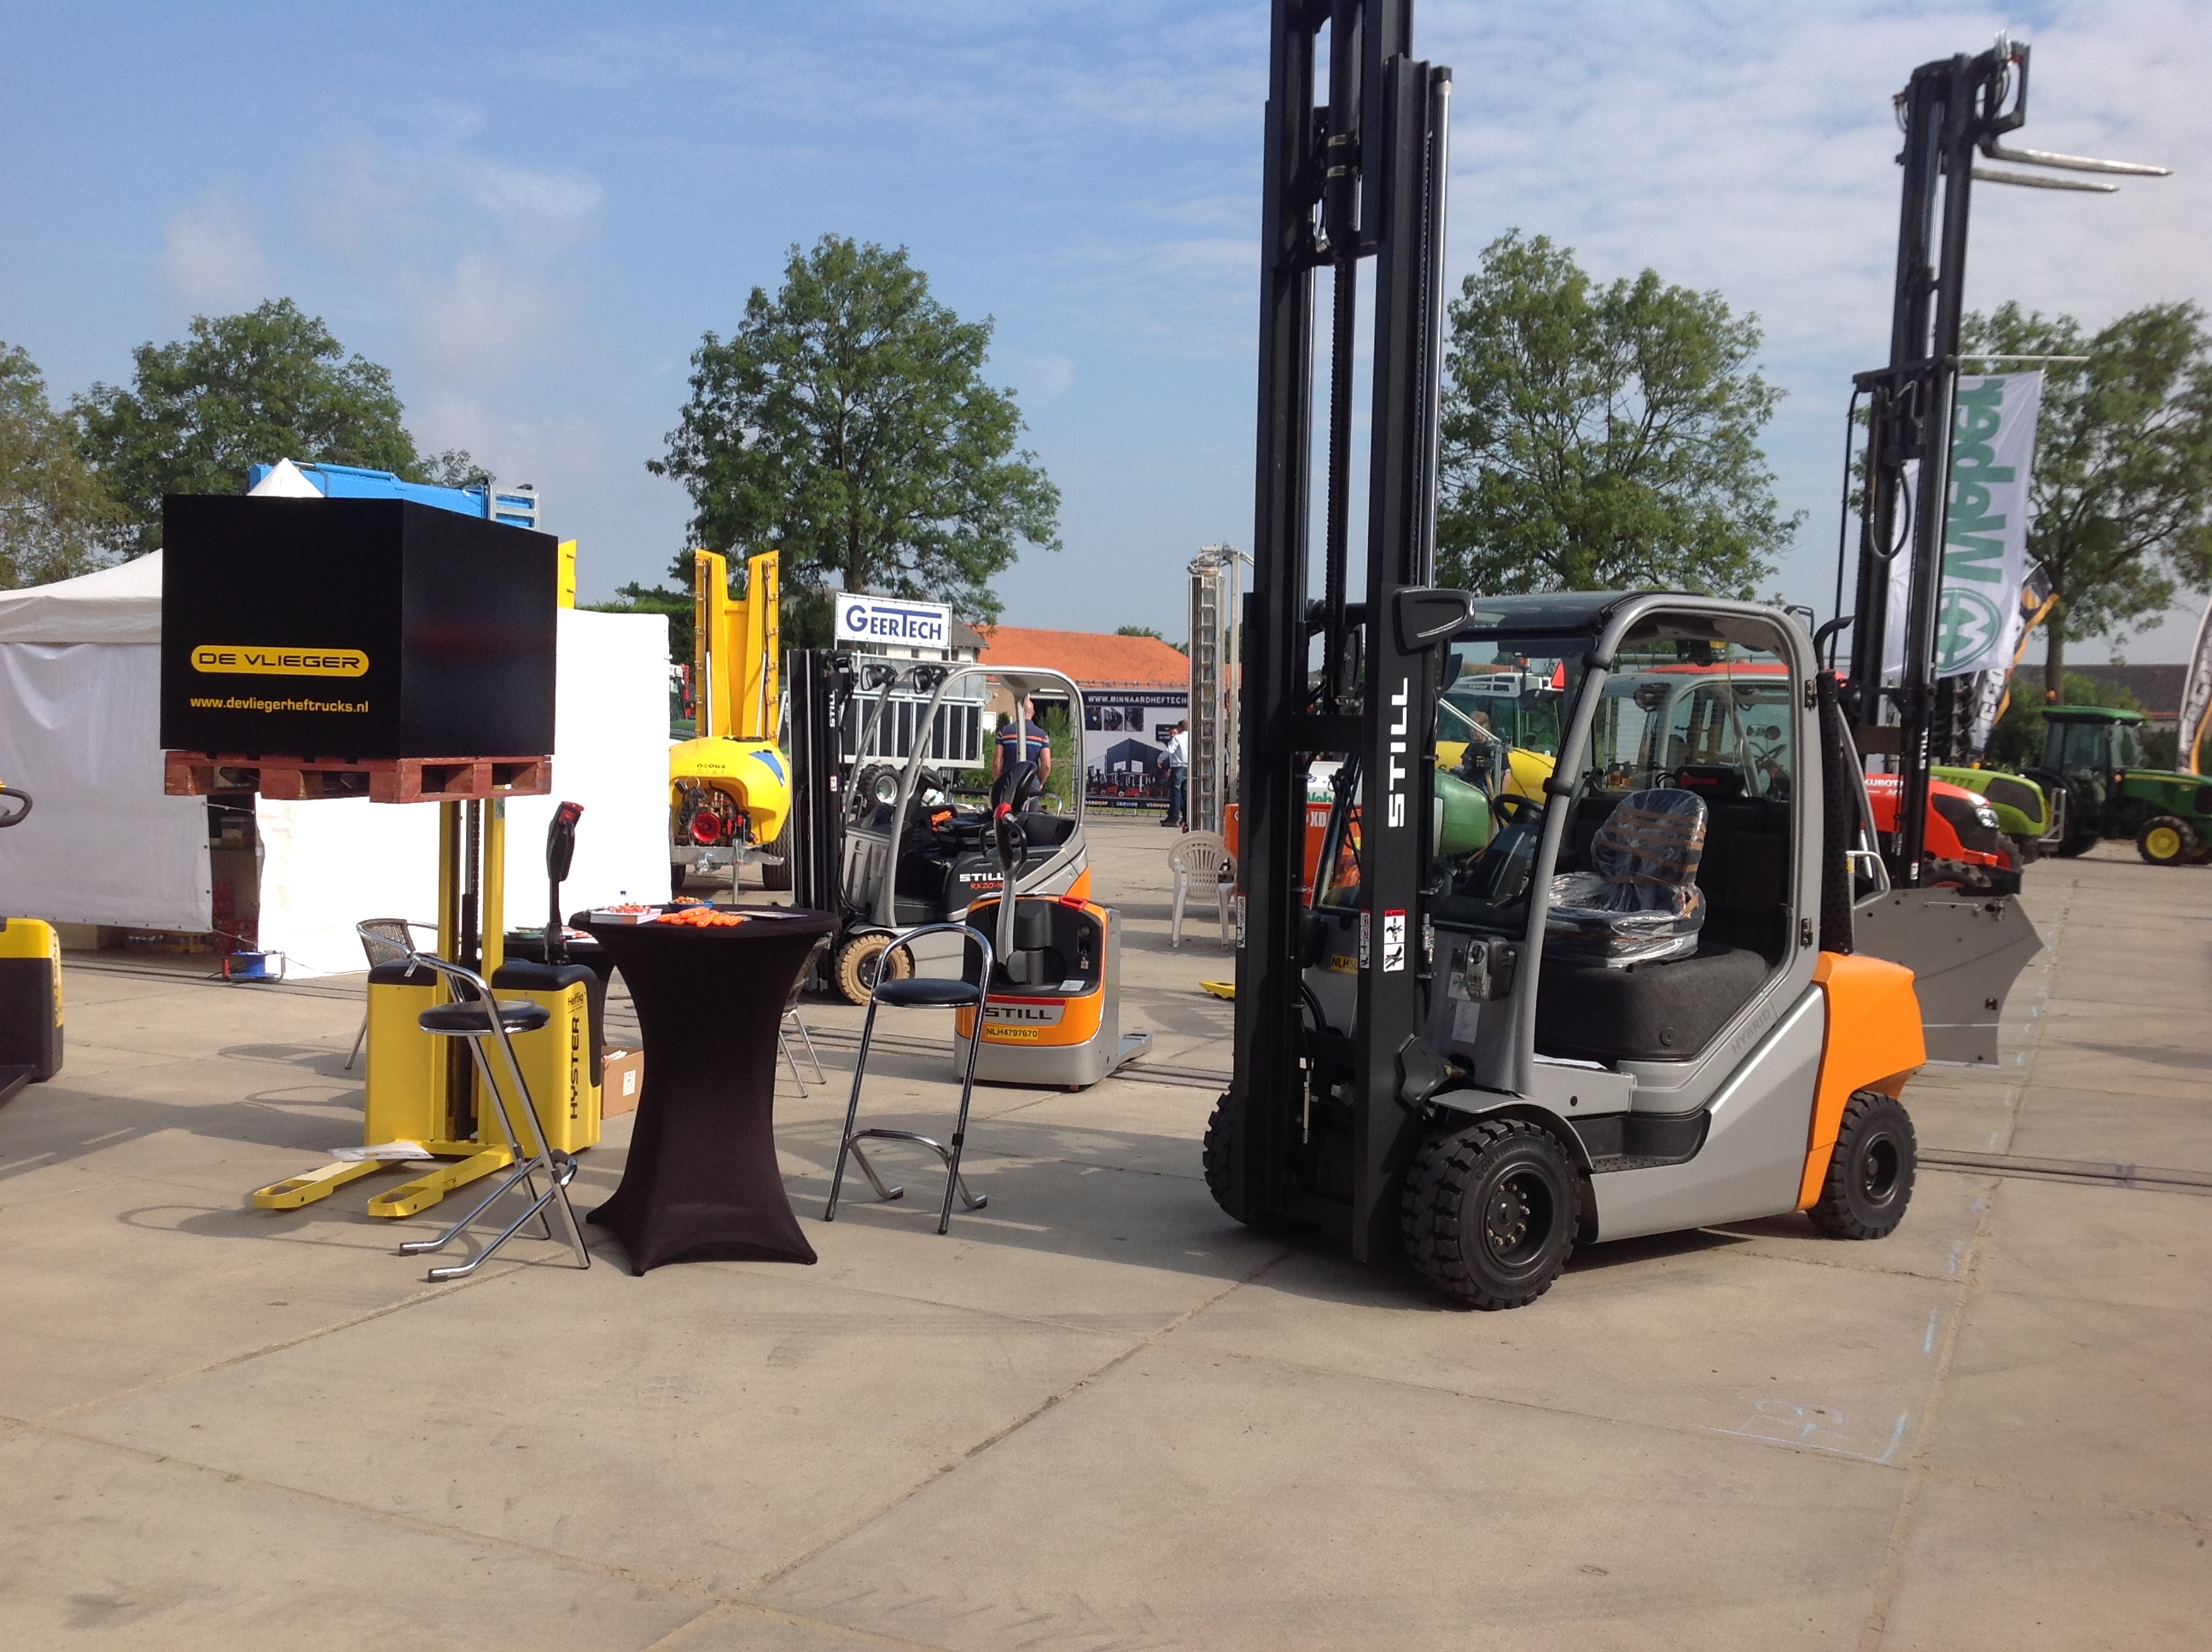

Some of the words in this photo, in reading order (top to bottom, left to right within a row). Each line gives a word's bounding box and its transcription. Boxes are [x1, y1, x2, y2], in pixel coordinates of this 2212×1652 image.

[199, 652, 236, 666] DE
[244, 653, 360, 669] VLIEGER
[189, 696, 370, 713] www.devliegerheftrucks.nl
[1388, 677, 1408, 828] STILL
[1918, 726, 1929, 770] STILL
[959, 873, 1004, 882] STILL
[985, 1007, 1052, 1020] STILL
[987, 1027, 1038, 1037] NLH4797670
[1731, 1009, 1771, 1054] HYBRID
[570, 1017, 579, 1120] HYSTER
